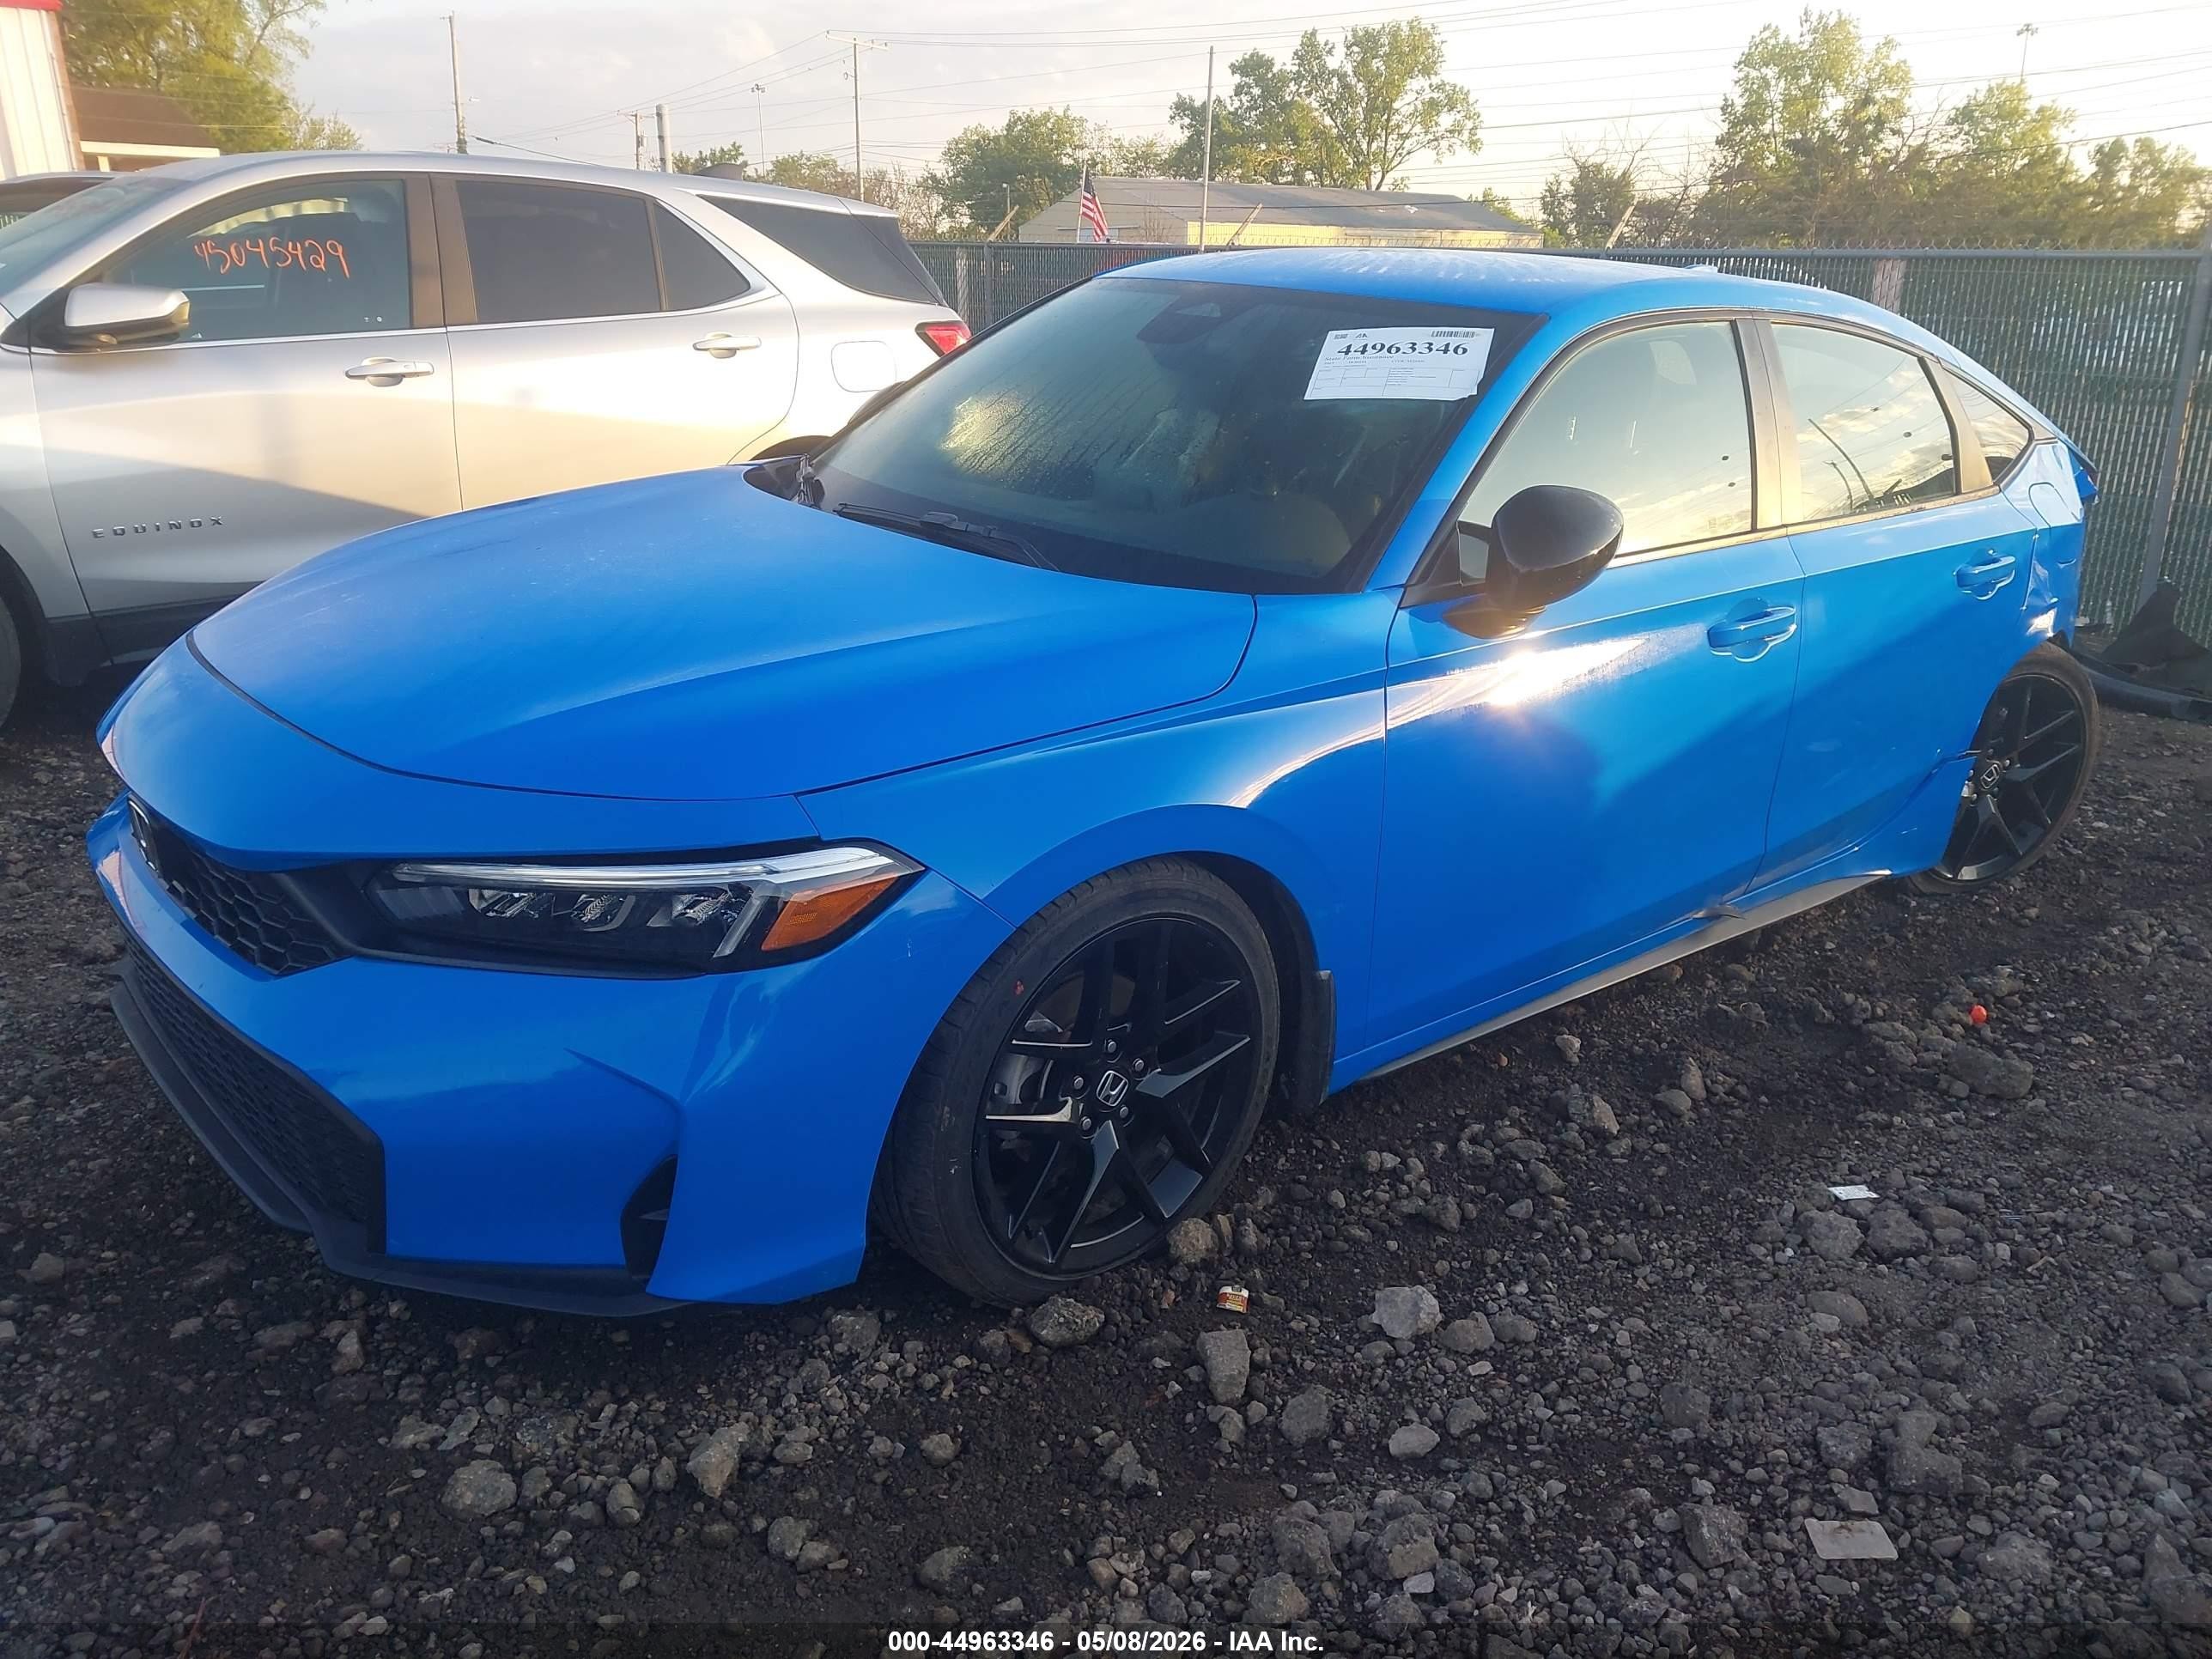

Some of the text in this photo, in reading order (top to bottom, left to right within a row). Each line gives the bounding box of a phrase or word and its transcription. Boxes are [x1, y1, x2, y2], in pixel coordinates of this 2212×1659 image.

[194, 236, 349, 279] 45045429
[1336, 342, 1470, 356] 44963346
[92, 516, 223, 538] EQUINOX
